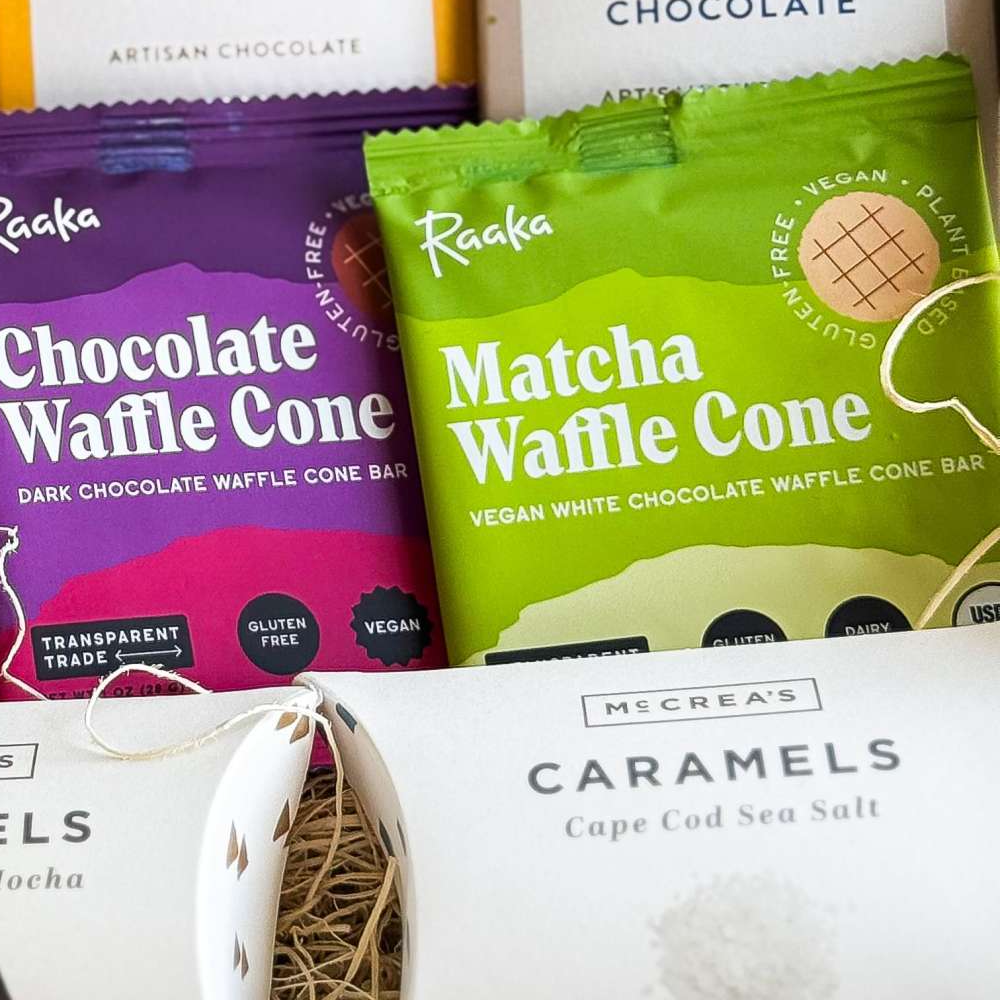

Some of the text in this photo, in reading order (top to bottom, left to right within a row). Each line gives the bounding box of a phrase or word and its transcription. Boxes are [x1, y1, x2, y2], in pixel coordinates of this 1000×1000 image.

[109, 38, 361, 65] ARTISAN CHOCOLATE
[802, 169, 889, 196] VEGAN
[414, 204, 553, 278] Raaka
[916, 184, 969, 256] PLANT
[437, 323, 703, 410] Matcha
[229, 384, 395, 448] Cone
[447, 391, 872, 485] Waffle Cone
[18, 462, 408, 504] DARK CHOCOLATE WAFFLE CONE BAR
[469, 453, 985, 528] VEGAN WHITE CHOCOLATE WAFFLE CONE BAR
[41, 626, 180, 651] TRANSPARENT
[247, 617, 306, 634] GLUTEN
[261, 633, 299, 648] FREE
[364, 618, 421, 635] VEGAN
[845, 622, 891, 637] DAIRY
[43, 650, 108, 669] TRADE
[527, 738, 901, 795] CARAMELS
[564, 796, 880, 842] Cape Cod Sea Salt
